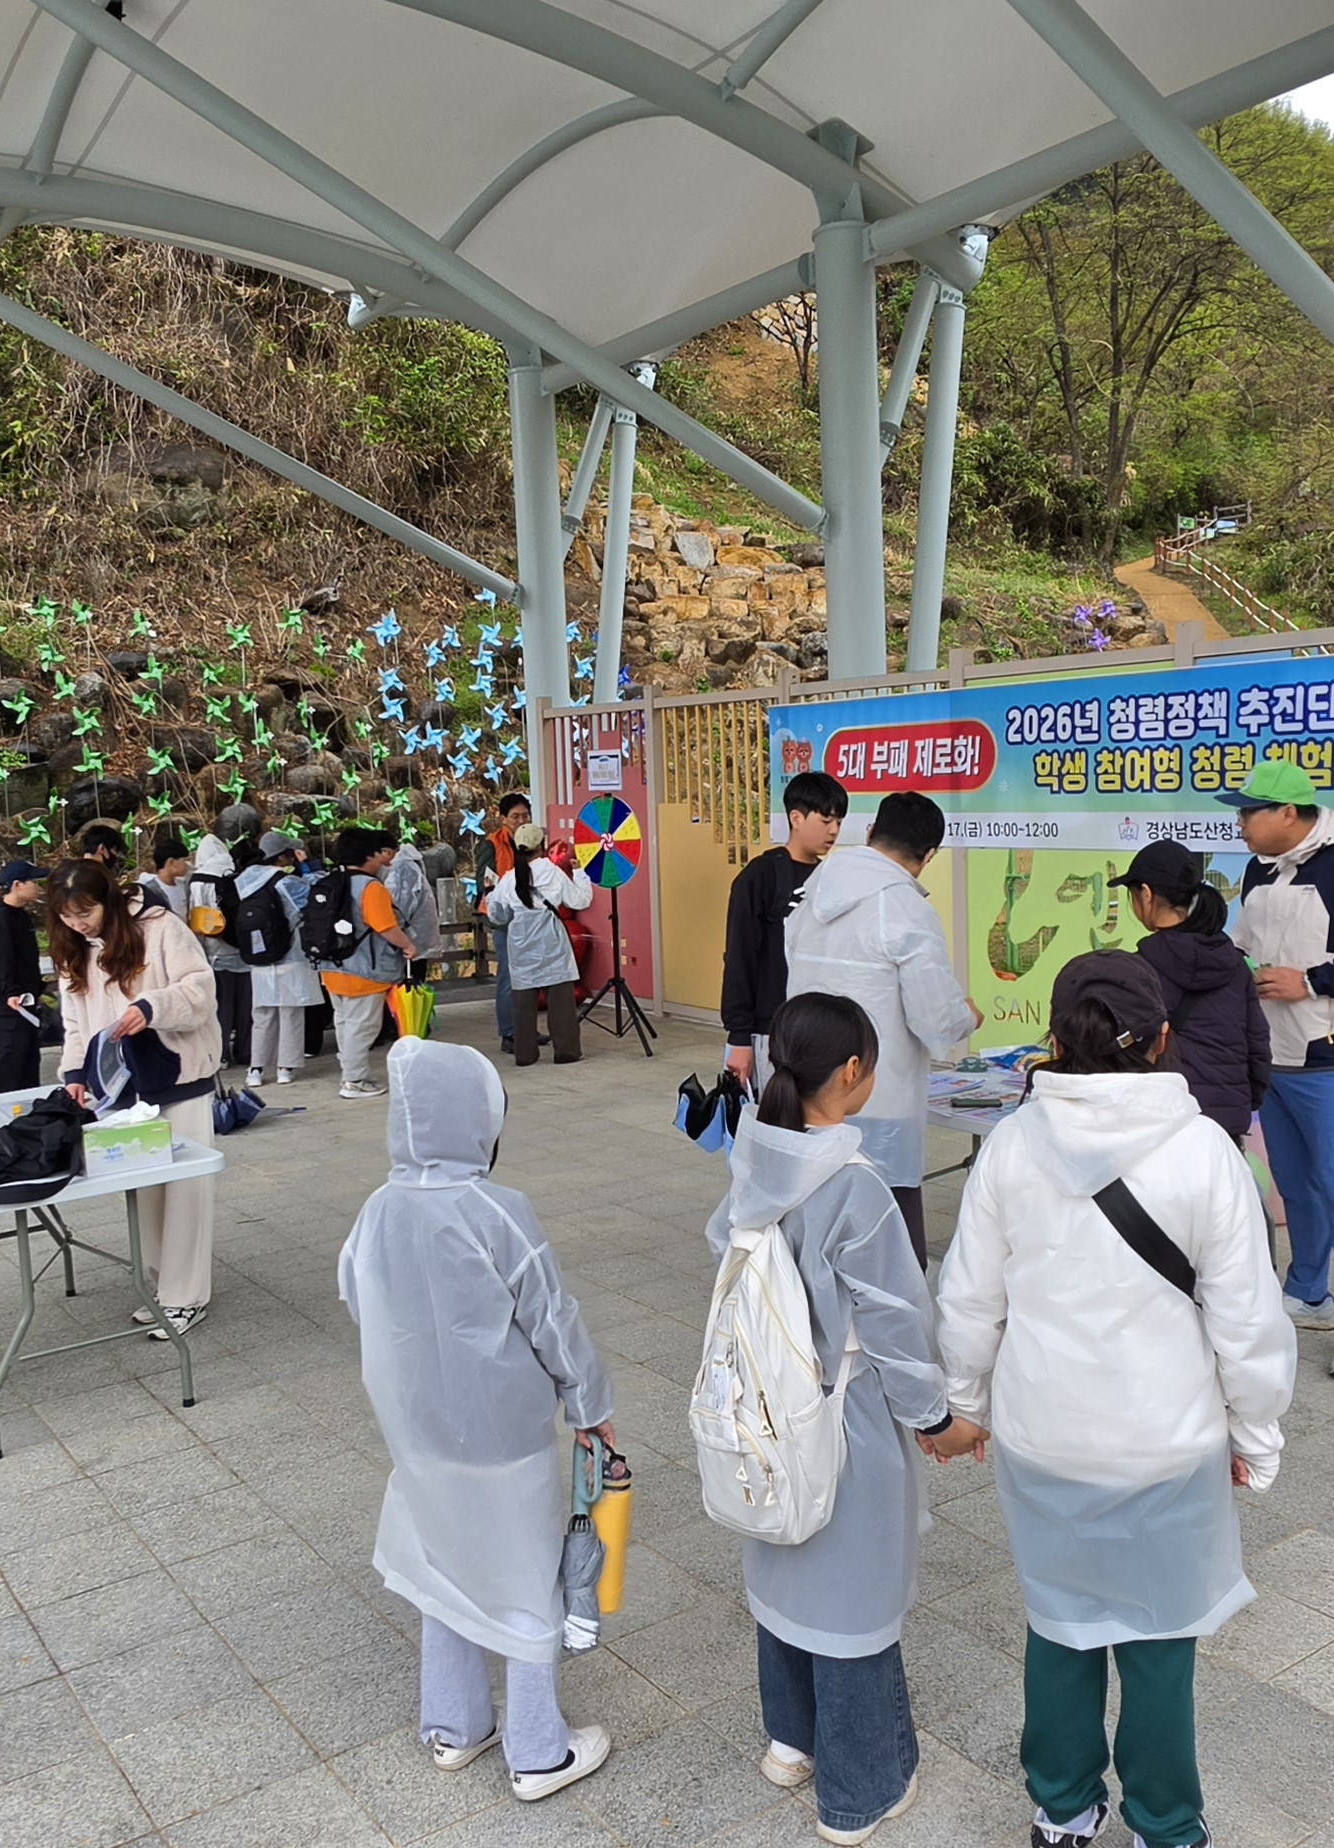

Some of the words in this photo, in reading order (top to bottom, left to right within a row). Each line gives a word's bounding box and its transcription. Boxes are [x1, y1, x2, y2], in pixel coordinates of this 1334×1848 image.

[1006, 698, 1100, 743] 2026년
[1109, 688, 1229, 741] 청렴정책
[837, 742, 865, 779] 5대
[871, 739, 908, 779] 부패
[913, 735, 980, 777] 제로화!
[1035, 750, 1087, 792] 학생
[1095, 744, 1181, 791] 참여형
[1192, 742, 1254, 791] 청렴
[987, 822, 1059, 838] 10:00~12:00
[993, 995, 1041, 1025] SAN
